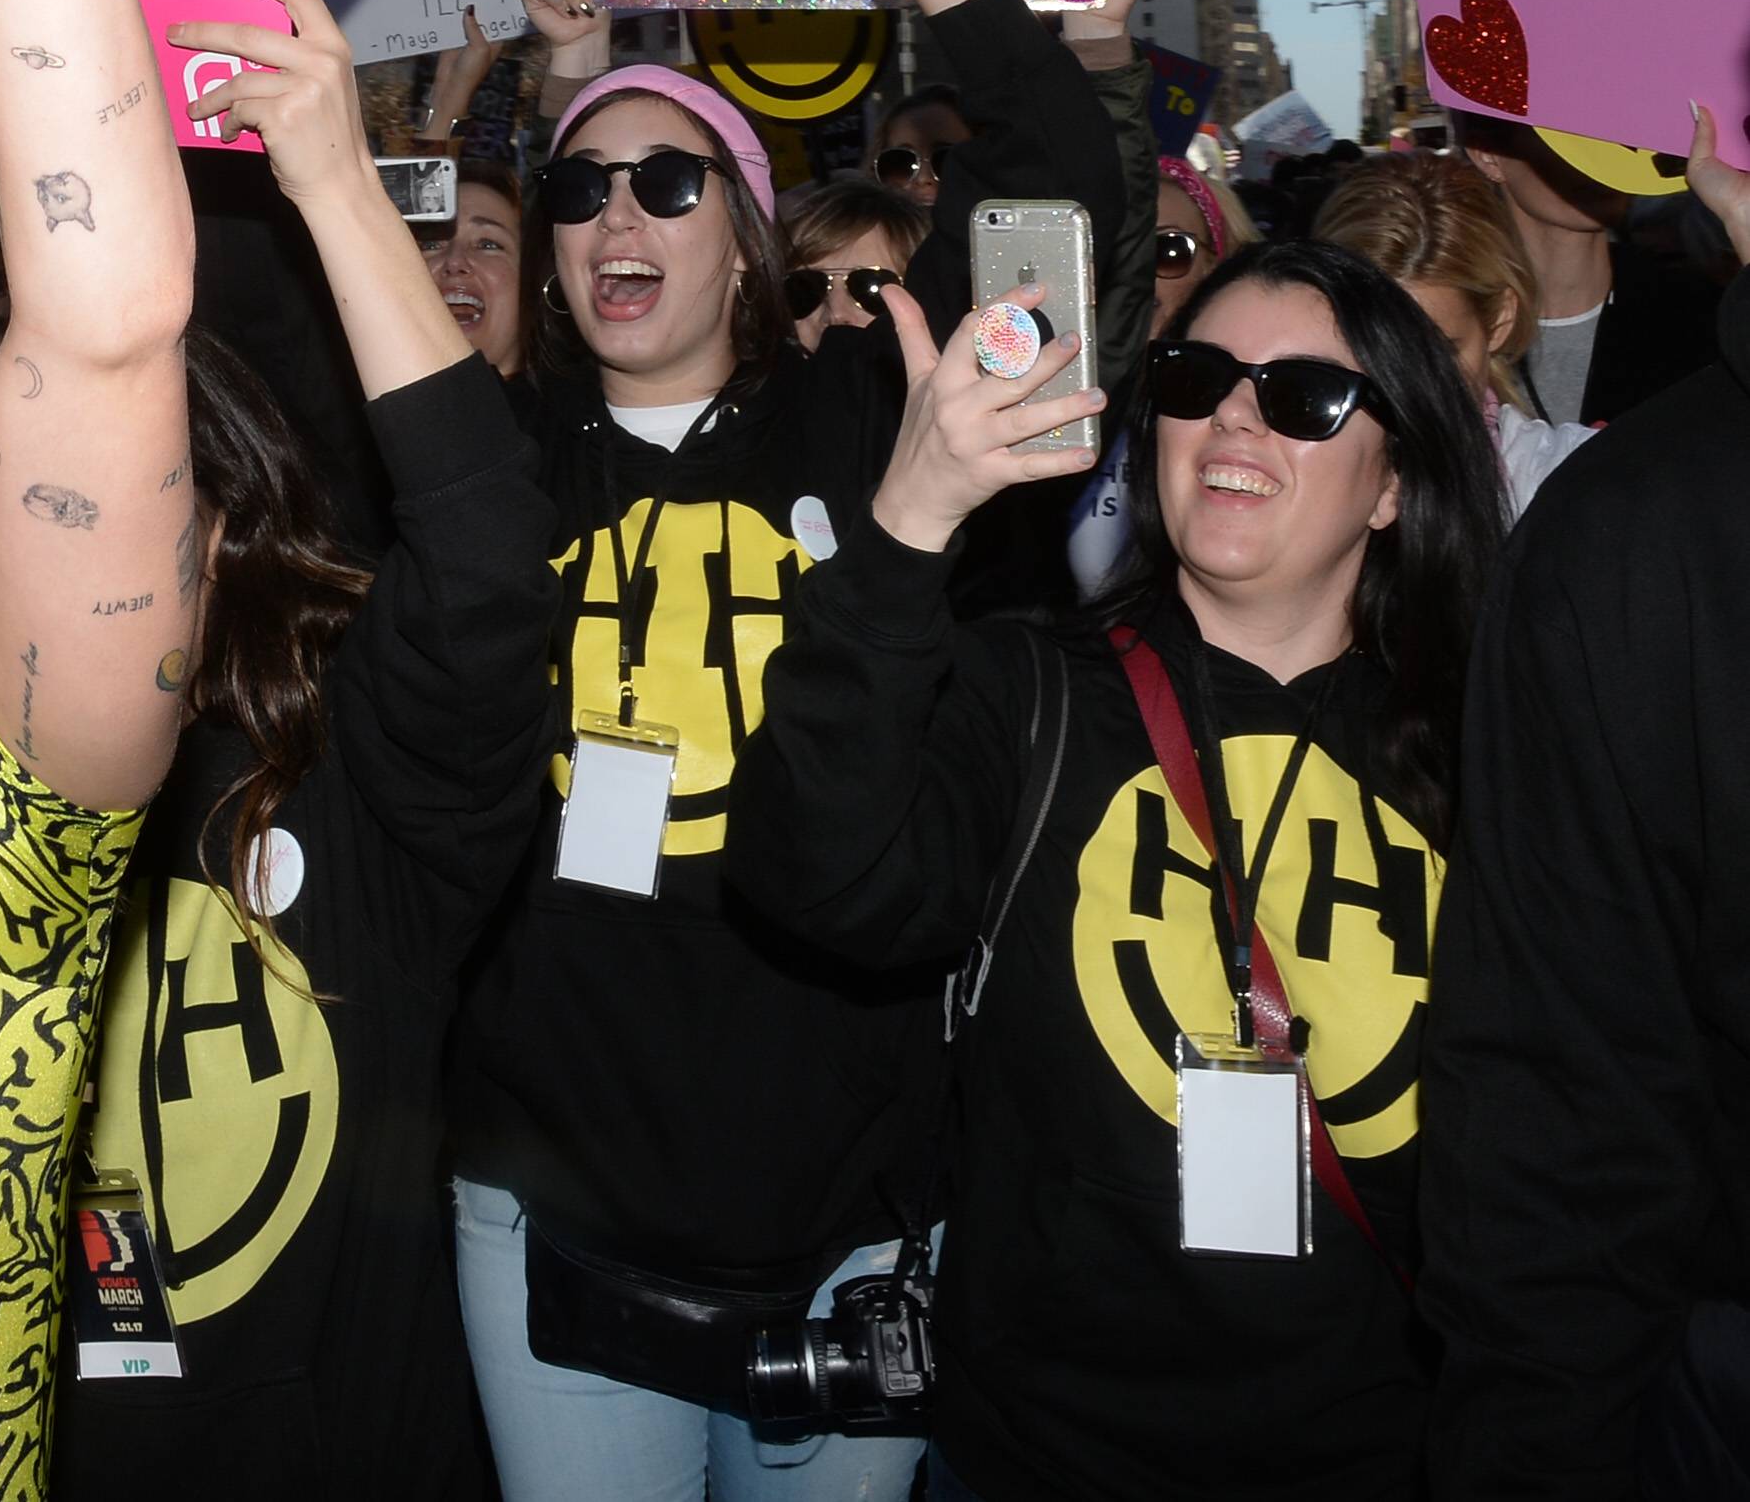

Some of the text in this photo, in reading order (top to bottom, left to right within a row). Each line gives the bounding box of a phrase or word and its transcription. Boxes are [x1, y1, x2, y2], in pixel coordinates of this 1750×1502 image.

[386, 31, 439, 53] Maya
[96, 81, 149, 126] LEETLE
[92, 593, 155, 616] BIEWTY
[97, 1276, 139, 1288] WOMEN'S
[98, 1289, 144, 1305] MARCH
[112, 1321, 143, 1332] 1.21.17
[122, 1359, 150, 1374] VIP
